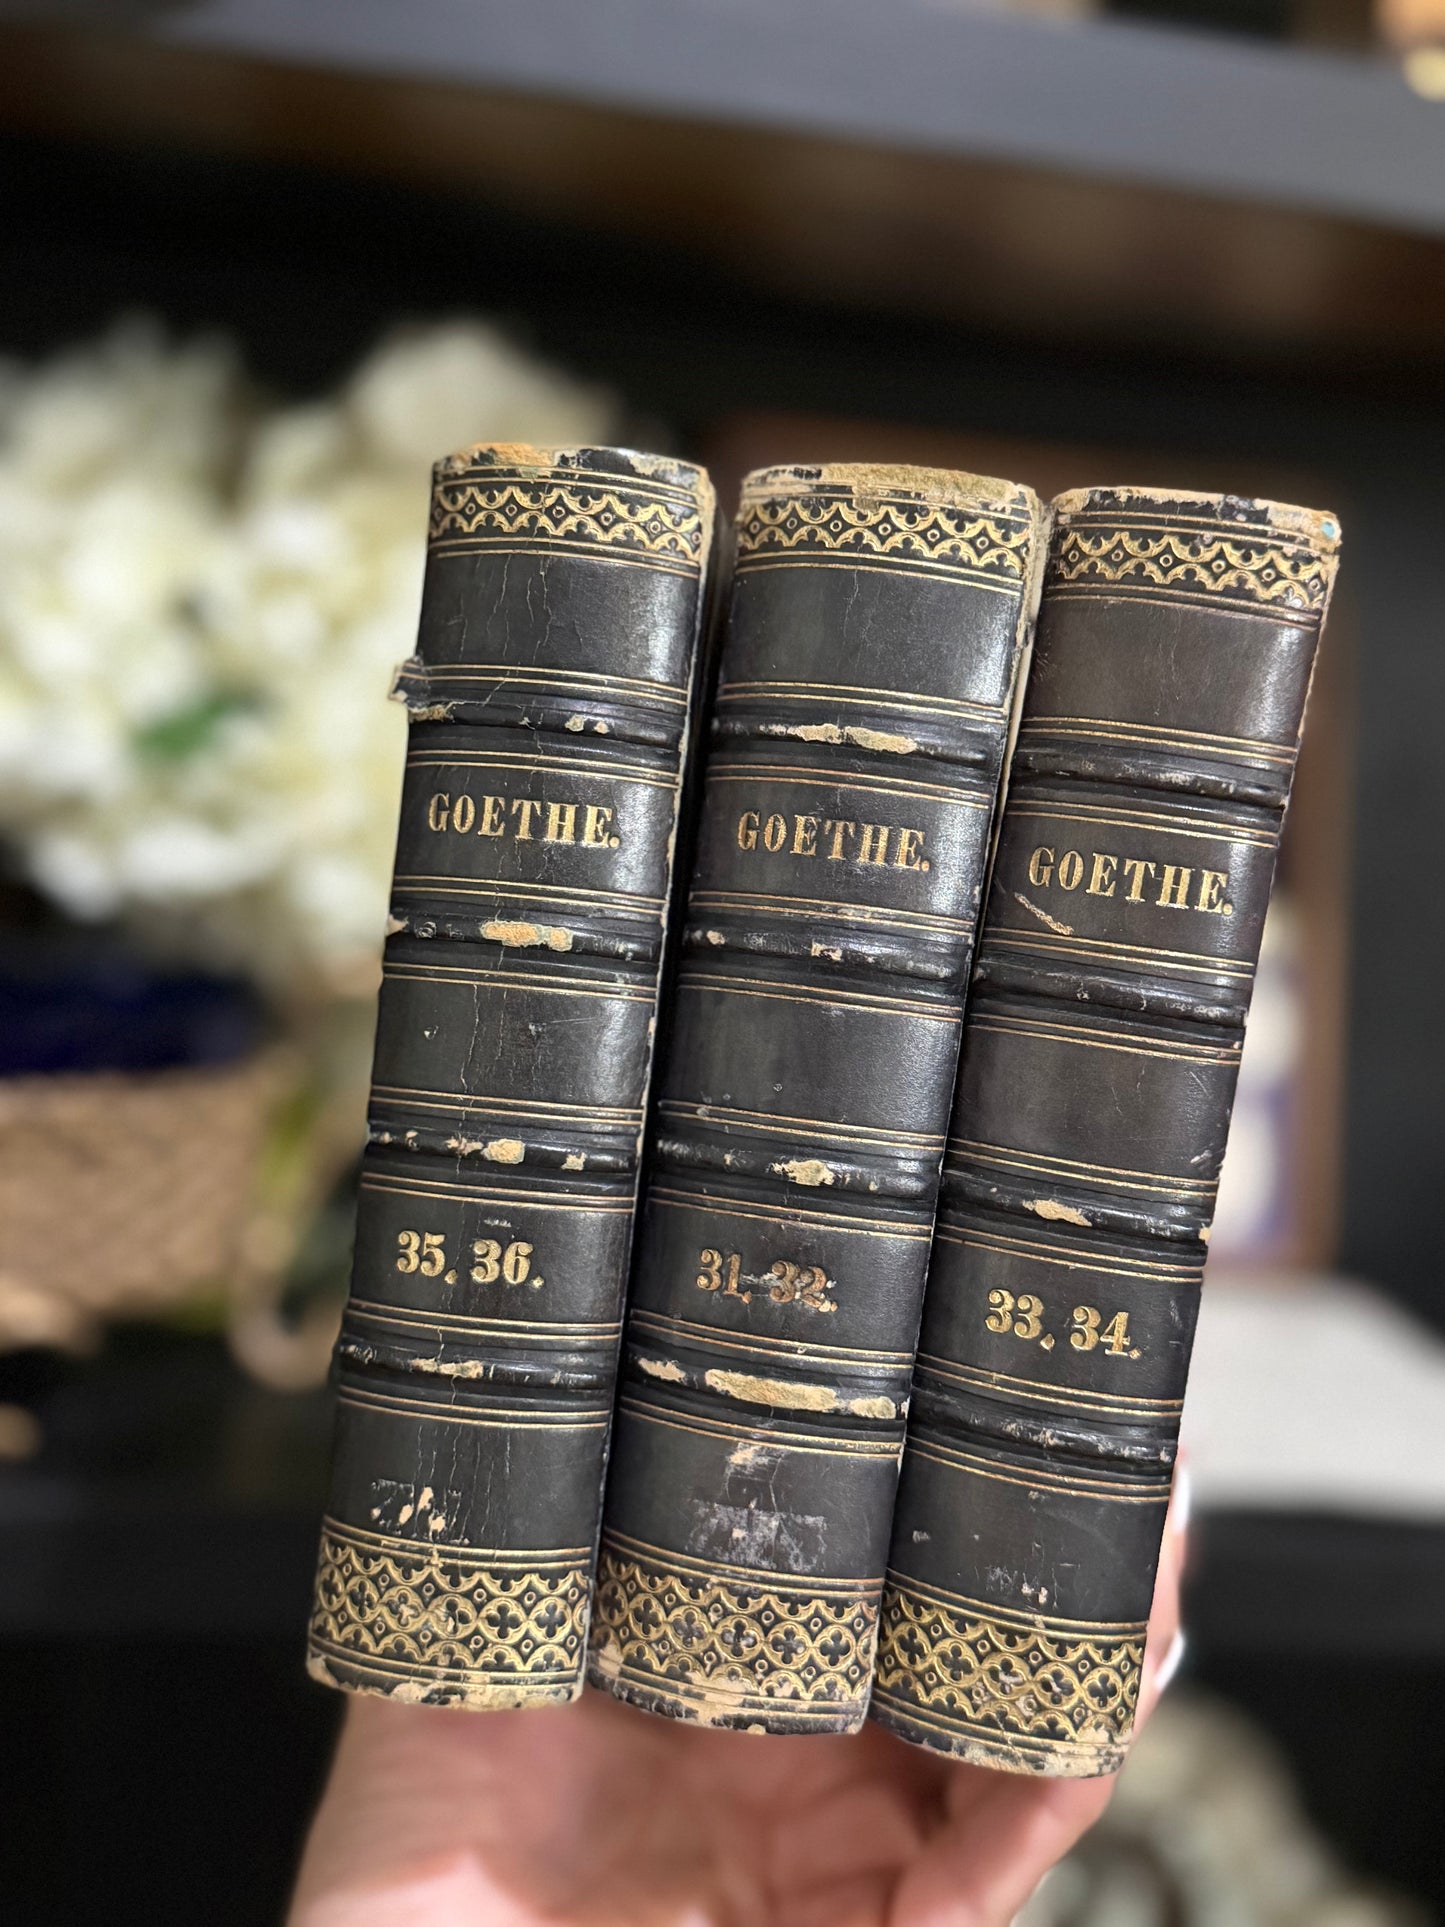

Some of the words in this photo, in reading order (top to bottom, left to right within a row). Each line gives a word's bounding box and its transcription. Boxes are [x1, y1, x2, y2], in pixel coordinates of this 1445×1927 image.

[429, 793, 620, 849] GOETHE.
[738, 811, 930, 872] GOETHE.
[1029, 847, 1233, 915] GOETHE.
[471, 1238, 544, 1288] 36.
[1070, 1306, 1142, 1360] 34.
